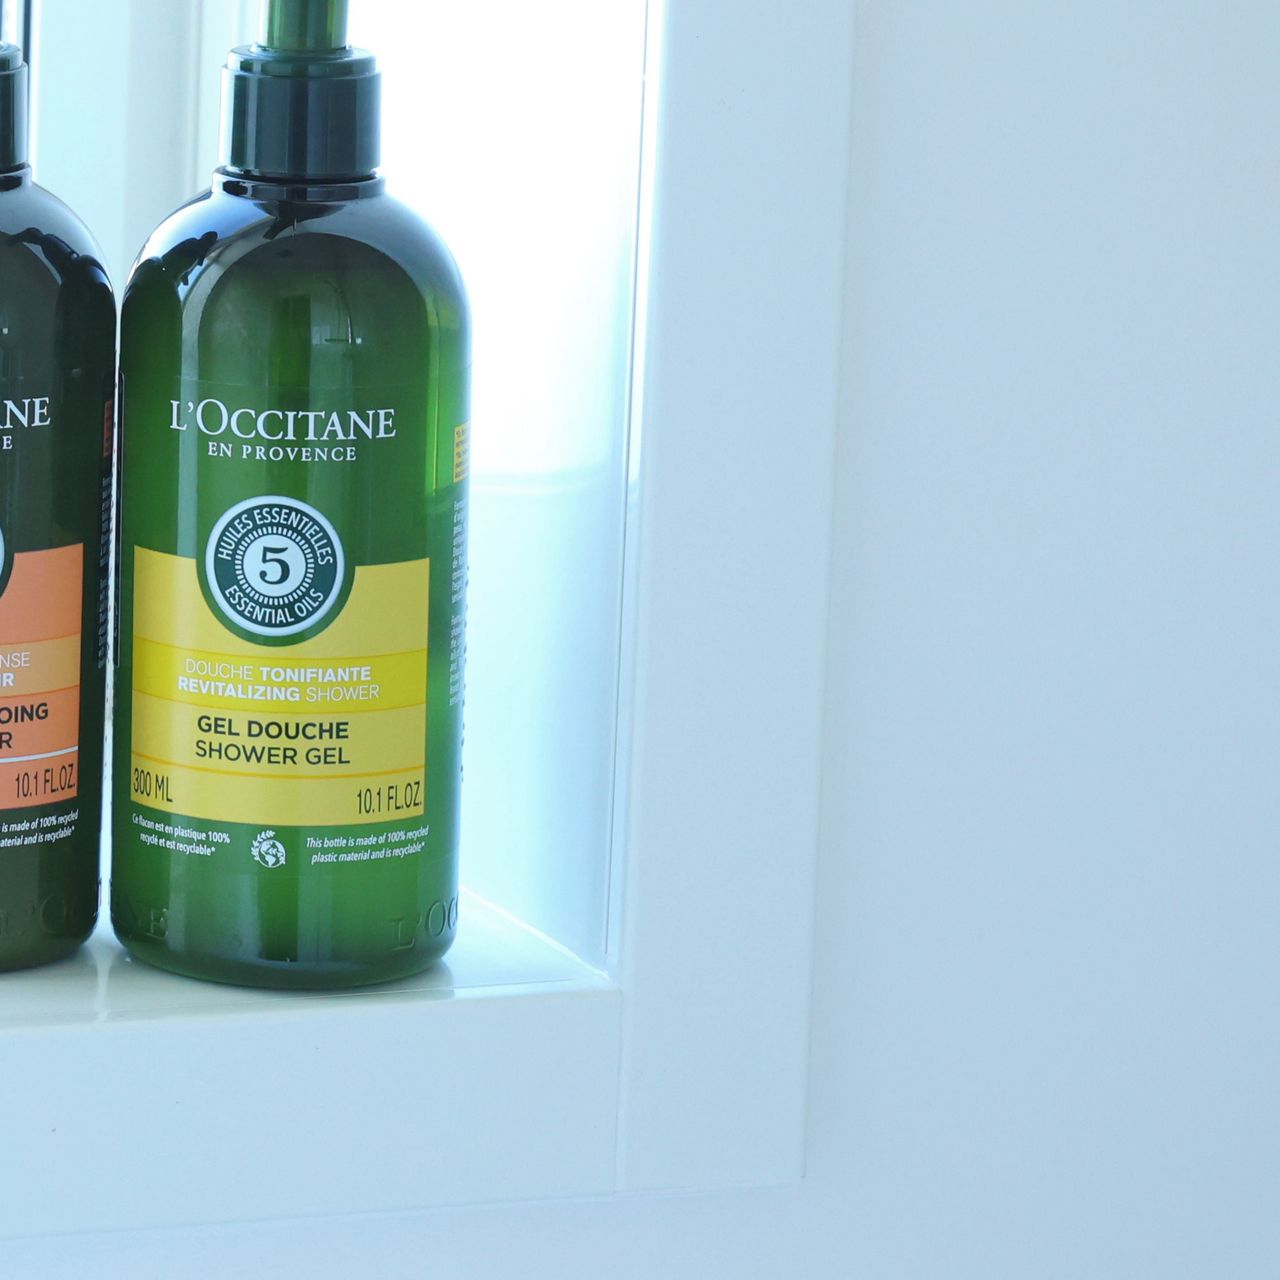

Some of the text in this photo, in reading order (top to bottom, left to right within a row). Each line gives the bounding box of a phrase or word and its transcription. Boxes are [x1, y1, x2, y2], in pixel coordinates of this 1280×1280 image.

[170, 399, 396, 441] L'OCCITANE
[208, 442, 356, 462] EN PROVENCE
[217, 507, 333, 565] HUILES ESSENTIELLES
[259, 546, 291, 585] 5
[225, 584, 324, 624] ESSENTIAL OILS
[185, 658, 371, 682] DOUCHE TONIFIANTE
[178, 676, 379, 702] REVITALIZING SHOWER
[198, 715, 349, 739] GEL DOUCHE
[195, 740, 350, 765] SHOWER GEL
[15, 773, 38, 798] 10.1
[133, 768, 173, 803] 300 ML
[357, 788, 382, 814] 10.1
[2, 822, 8, 832] is
[9, 820, 30, 831] made
[31, 818, 39, 829] of
[40, 816, 56, 828] 100%
[155, 823, 164, 832] est
[165, 825, 173, 834] en
[174, 826, 206, 841] plastique
[208, 831, 230, 843] 100%
[24, 833, 37, 845] and
[38, 831, 43, 842] is
[159, 838, 165, 847] et
[166, 840, 175, 849] est
[306, 838, 322, 848] This
[324, 837, 346, 847] bottle
[348, 837, 354, 846] is
[356, 834, 377, 846] made
[378, 833, 386, 843] of
[387, 831, 405, 842] 100%
[311, 853, 337, 865] plastic
[339, 850, 370, 861] material
[371, 848, 384, 859] and
[386, 848, 391, 857] is
